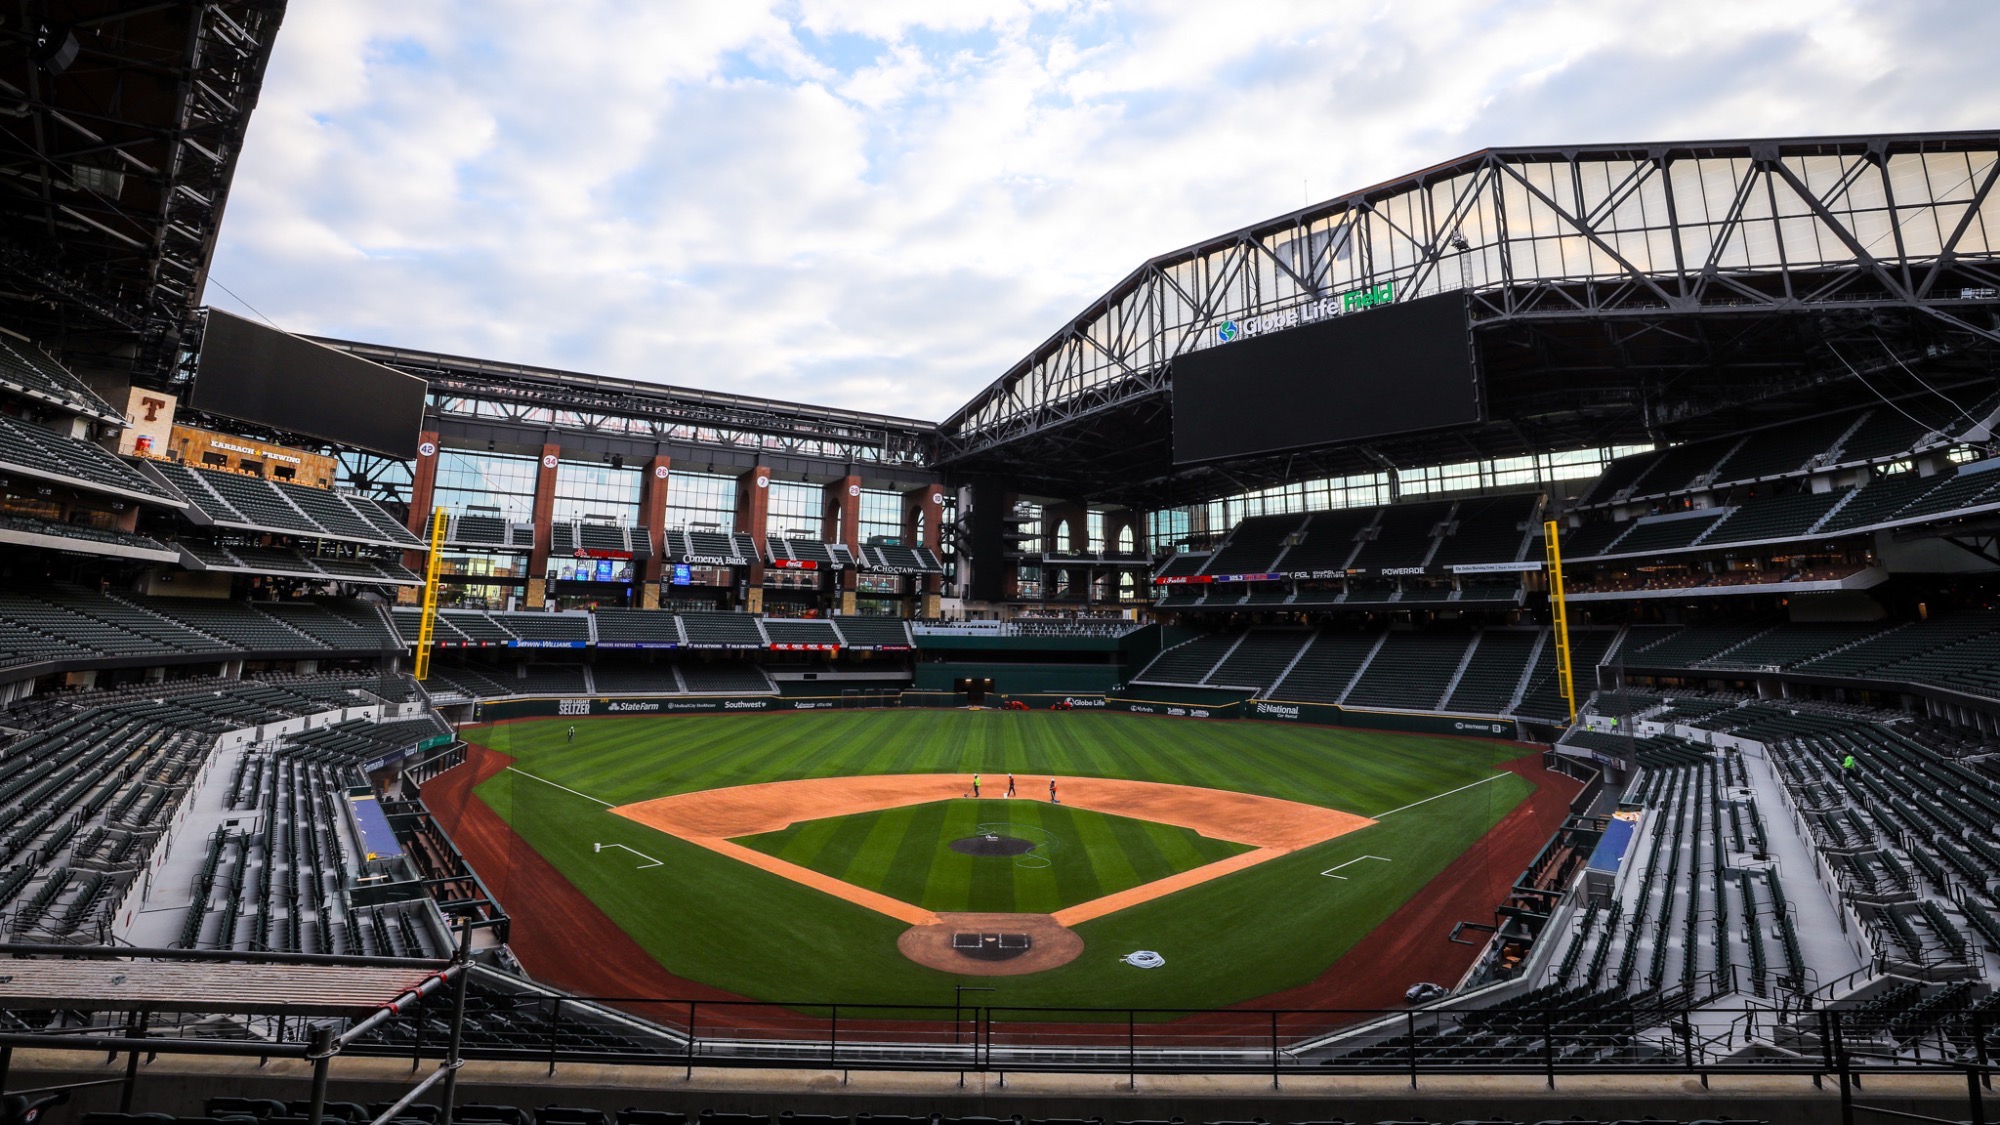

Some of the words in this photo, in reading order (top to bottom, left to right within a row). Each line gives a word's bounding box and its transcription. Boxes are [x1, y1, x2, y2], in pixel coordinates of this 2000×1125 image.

[1243, 311, 1299, 335] Globe
[1302, 298, 1340, 321] Life
[1343, 281, 1393, 312] Field
[141, 396, 166, 422] T
[210, 440, 255, 455] KARBACH
[420, 445, 433, 454] 42
[544, 457, 556, 466] 34
[656, 468, 667, 477] 26
[760, 478, 766, 486] 7
[850, 487, 859, 495] 29
[725, 558, 748, 566] Bank
[876, 564, 914, 574] CHOCTAW
[1381, 567, 1425, 576] POWERADE
[1294, 571, 1310, 579] PGL
[558, 703, 591, 715] SELTZER
[724, 701, 761, 709] Southwest
[1266, 704, 1298, 715] National
